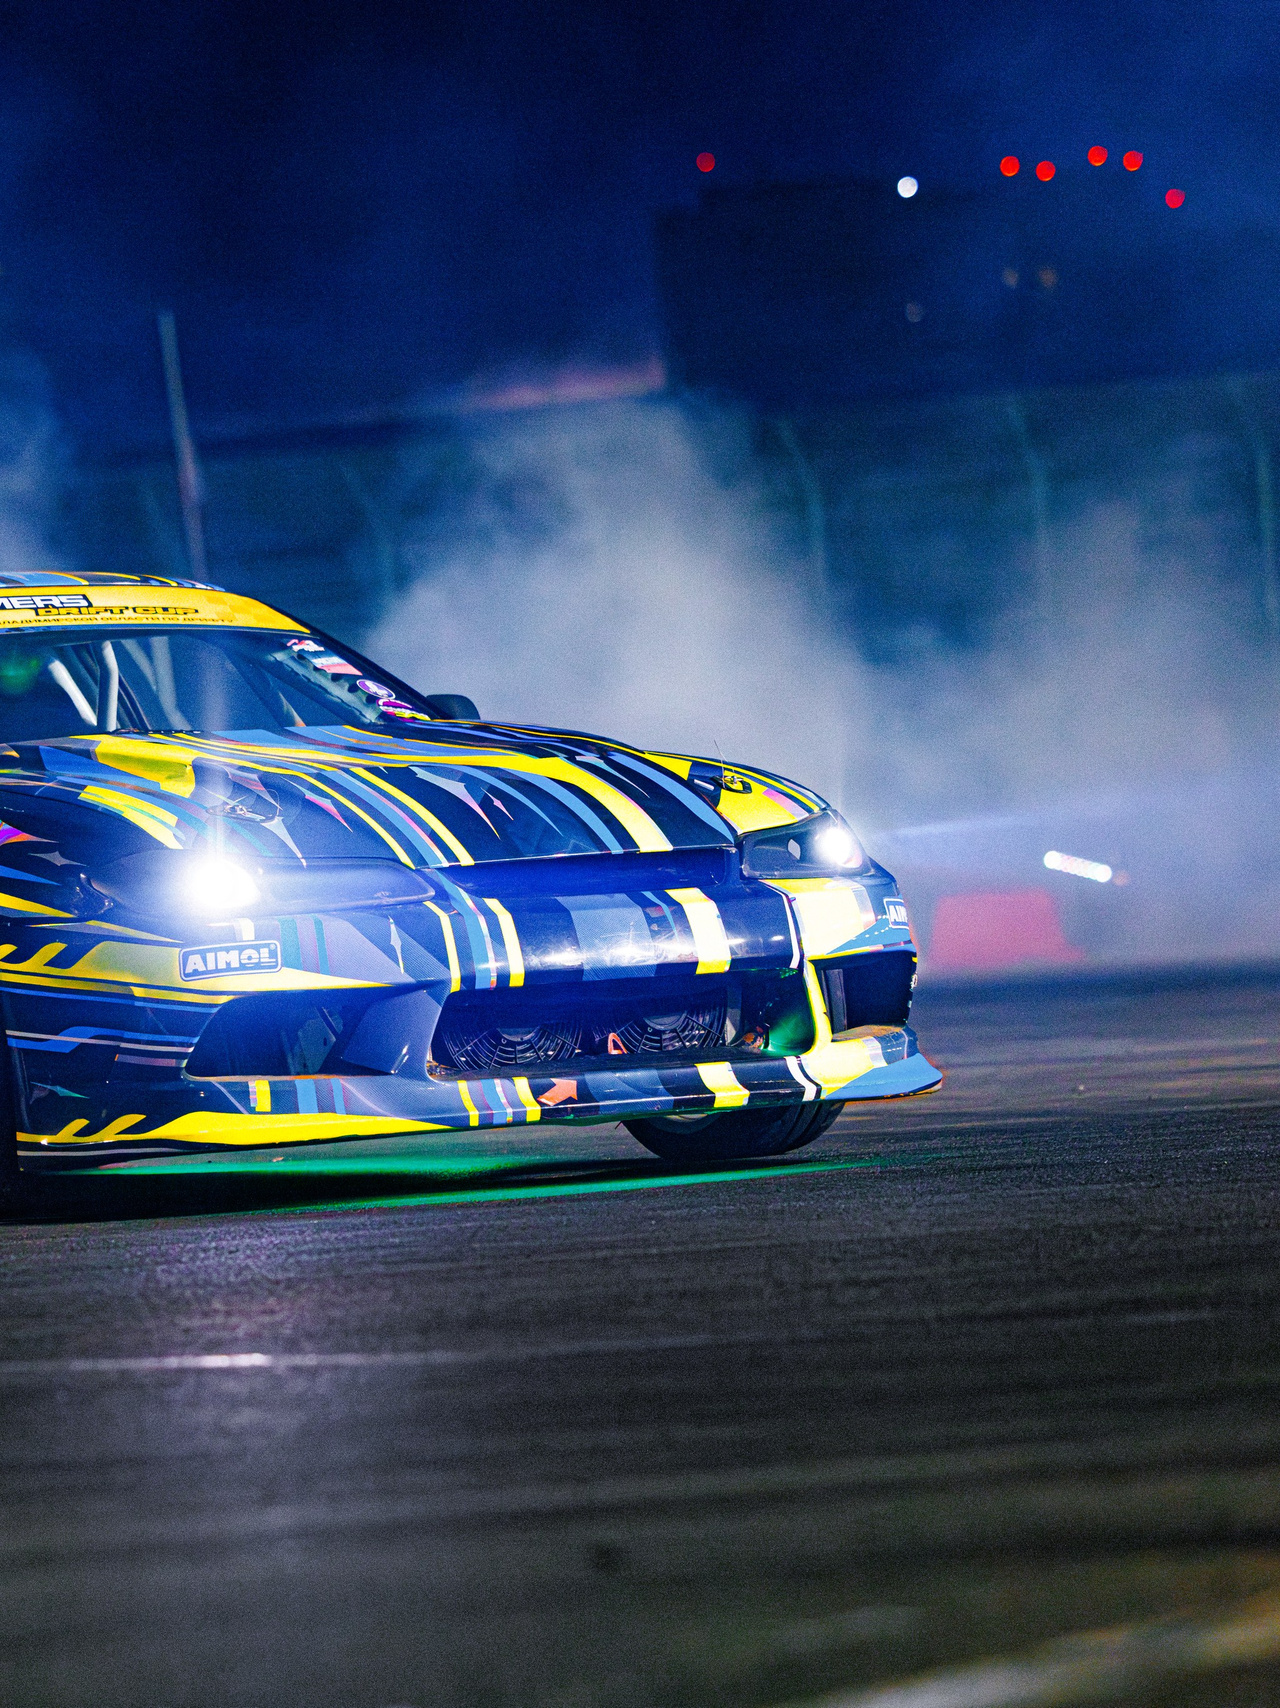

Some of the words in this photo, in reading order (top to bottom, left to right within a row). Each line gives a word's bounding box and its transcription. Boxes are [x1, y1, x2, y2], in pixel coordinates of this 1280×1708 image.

[35, 606, 130, 617] DRIFT
[133, 606, 199, 616] CUP
[185, 948, 276, 974] AIMOL
